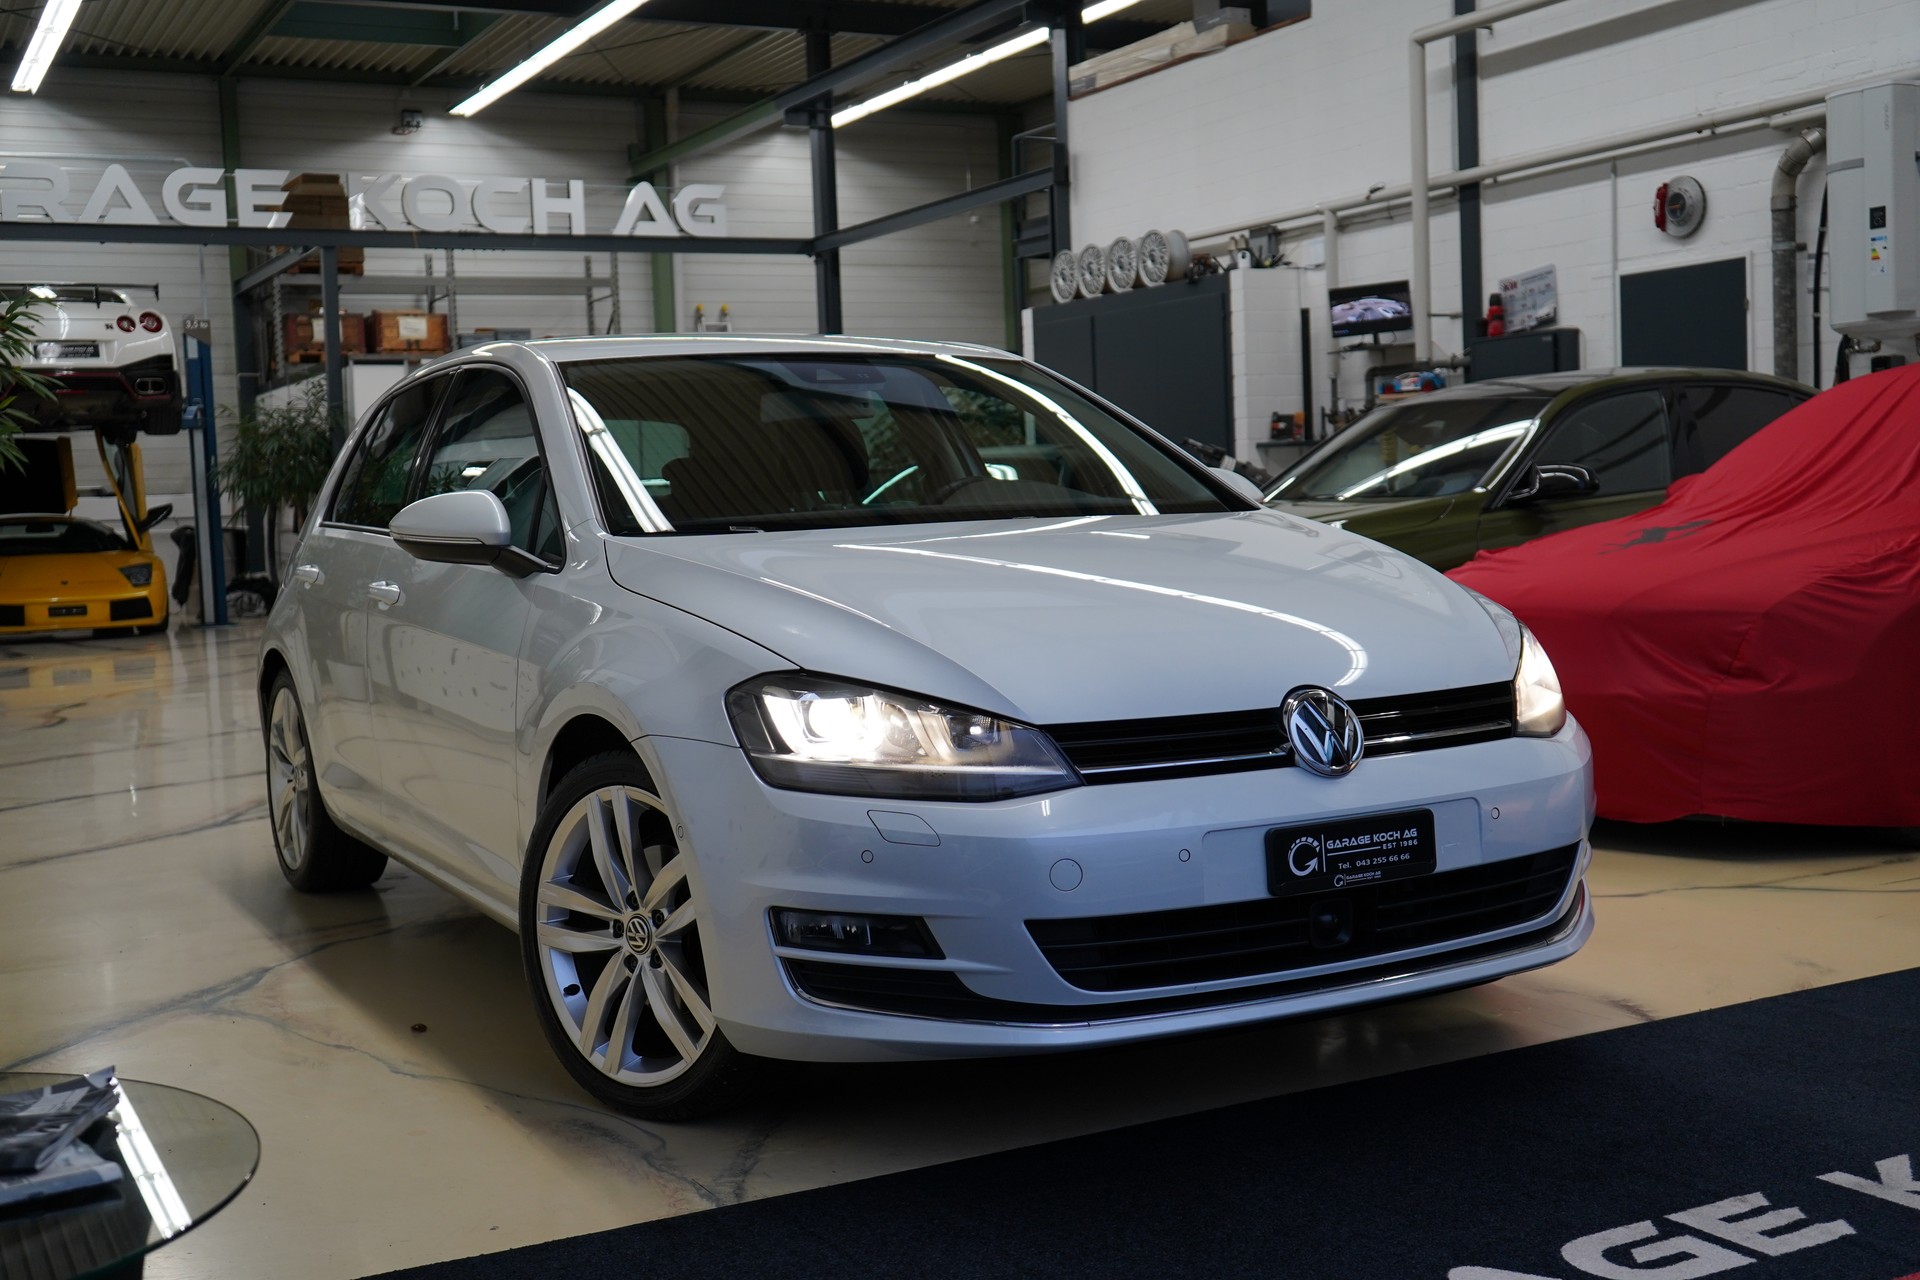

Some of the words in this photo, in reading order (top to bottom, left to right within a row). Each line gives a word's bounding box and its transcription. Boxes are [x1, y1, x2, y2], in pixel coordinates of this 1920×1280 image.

[359, 174, 586, 236] KOCH
[612, 180, 728, 237] AG
[1326, 834, 1372, 850] GARAGE
[1373, 830, 1401, 843] KOCH
[1402, 828, 1418, 839] AG
[1382, 842, 1397, 850] EST
[1400, 839, 1418, 847] 1986
[1338, 861, 1352, 870] Tel.
[1356, 858, 1371, 867] 043
[1372, 856, 1387, 865] 255
[1388, 854, 1399, 862] 66
[1400, 852, 1410, 860] 66
[1448, 1191, 1858, 1280] GE
